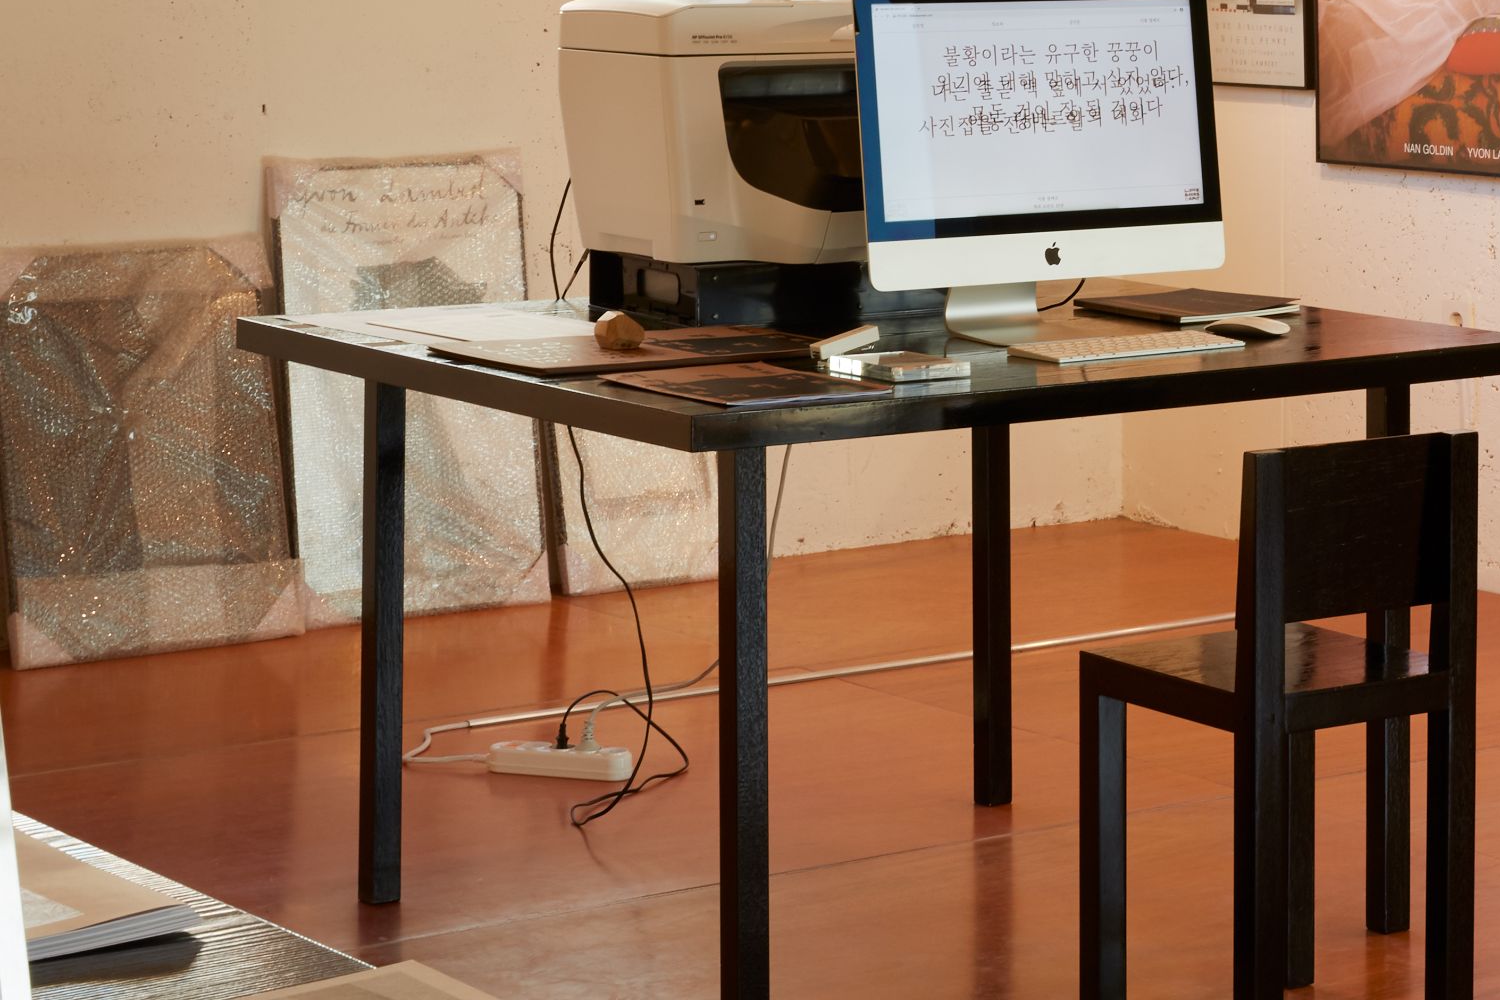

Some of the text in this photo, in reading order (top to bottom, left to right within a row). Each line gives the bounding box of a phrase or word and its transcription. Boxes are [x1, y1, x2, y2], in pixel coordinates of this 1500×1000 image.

[943, 40, 1158, 67] 불황이라는 유구한 꿍꿍이
[1404, 143, 1421, 153] NAN
[1423, 144, 1453, 156] GOLDIN
[1467, 147, 1491, 159] YVON
